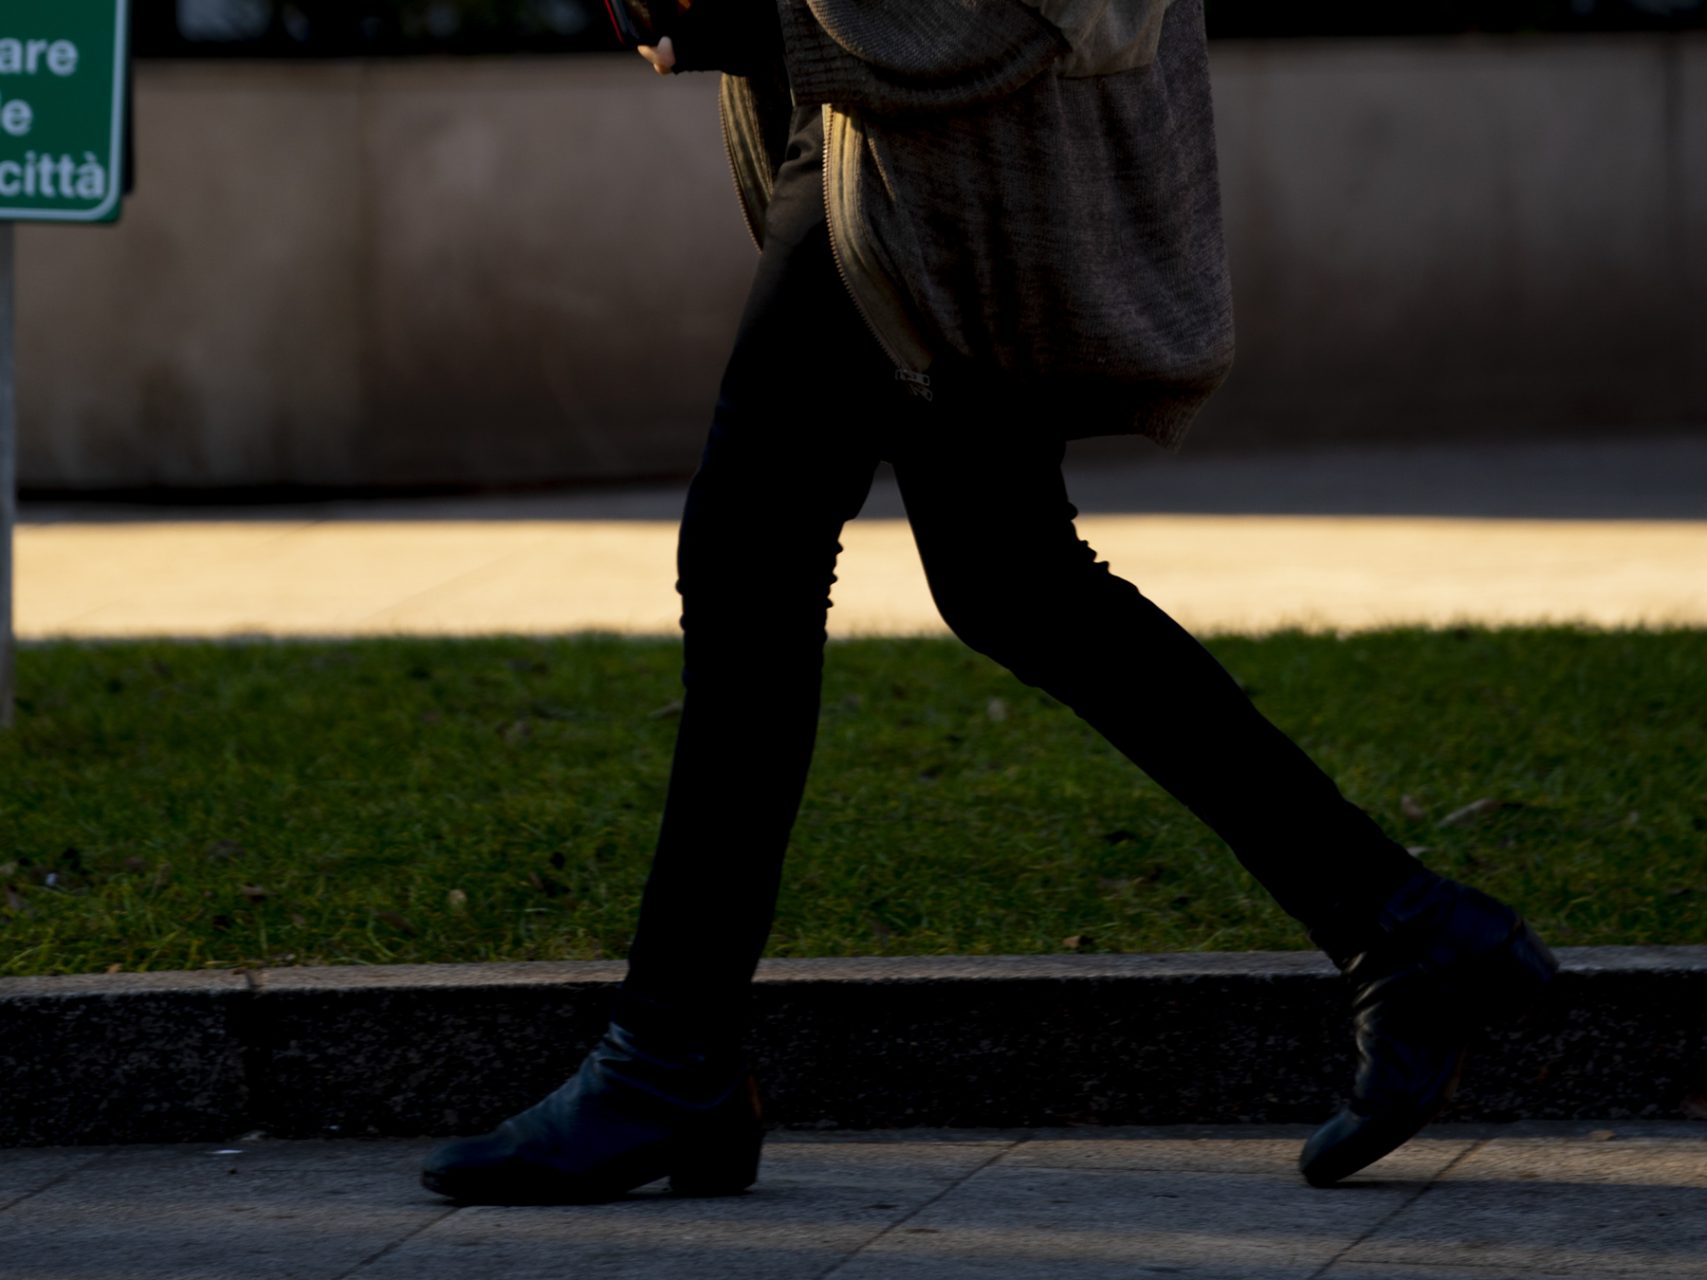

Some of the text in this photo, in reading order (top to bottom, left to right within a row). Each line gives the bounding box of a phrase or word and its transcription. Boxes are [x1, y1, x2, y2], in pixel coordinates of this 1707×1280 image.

[0, 37, 80, 77] are
[0, 90, 33, 138] e
[0, 150, 106, 201] città
